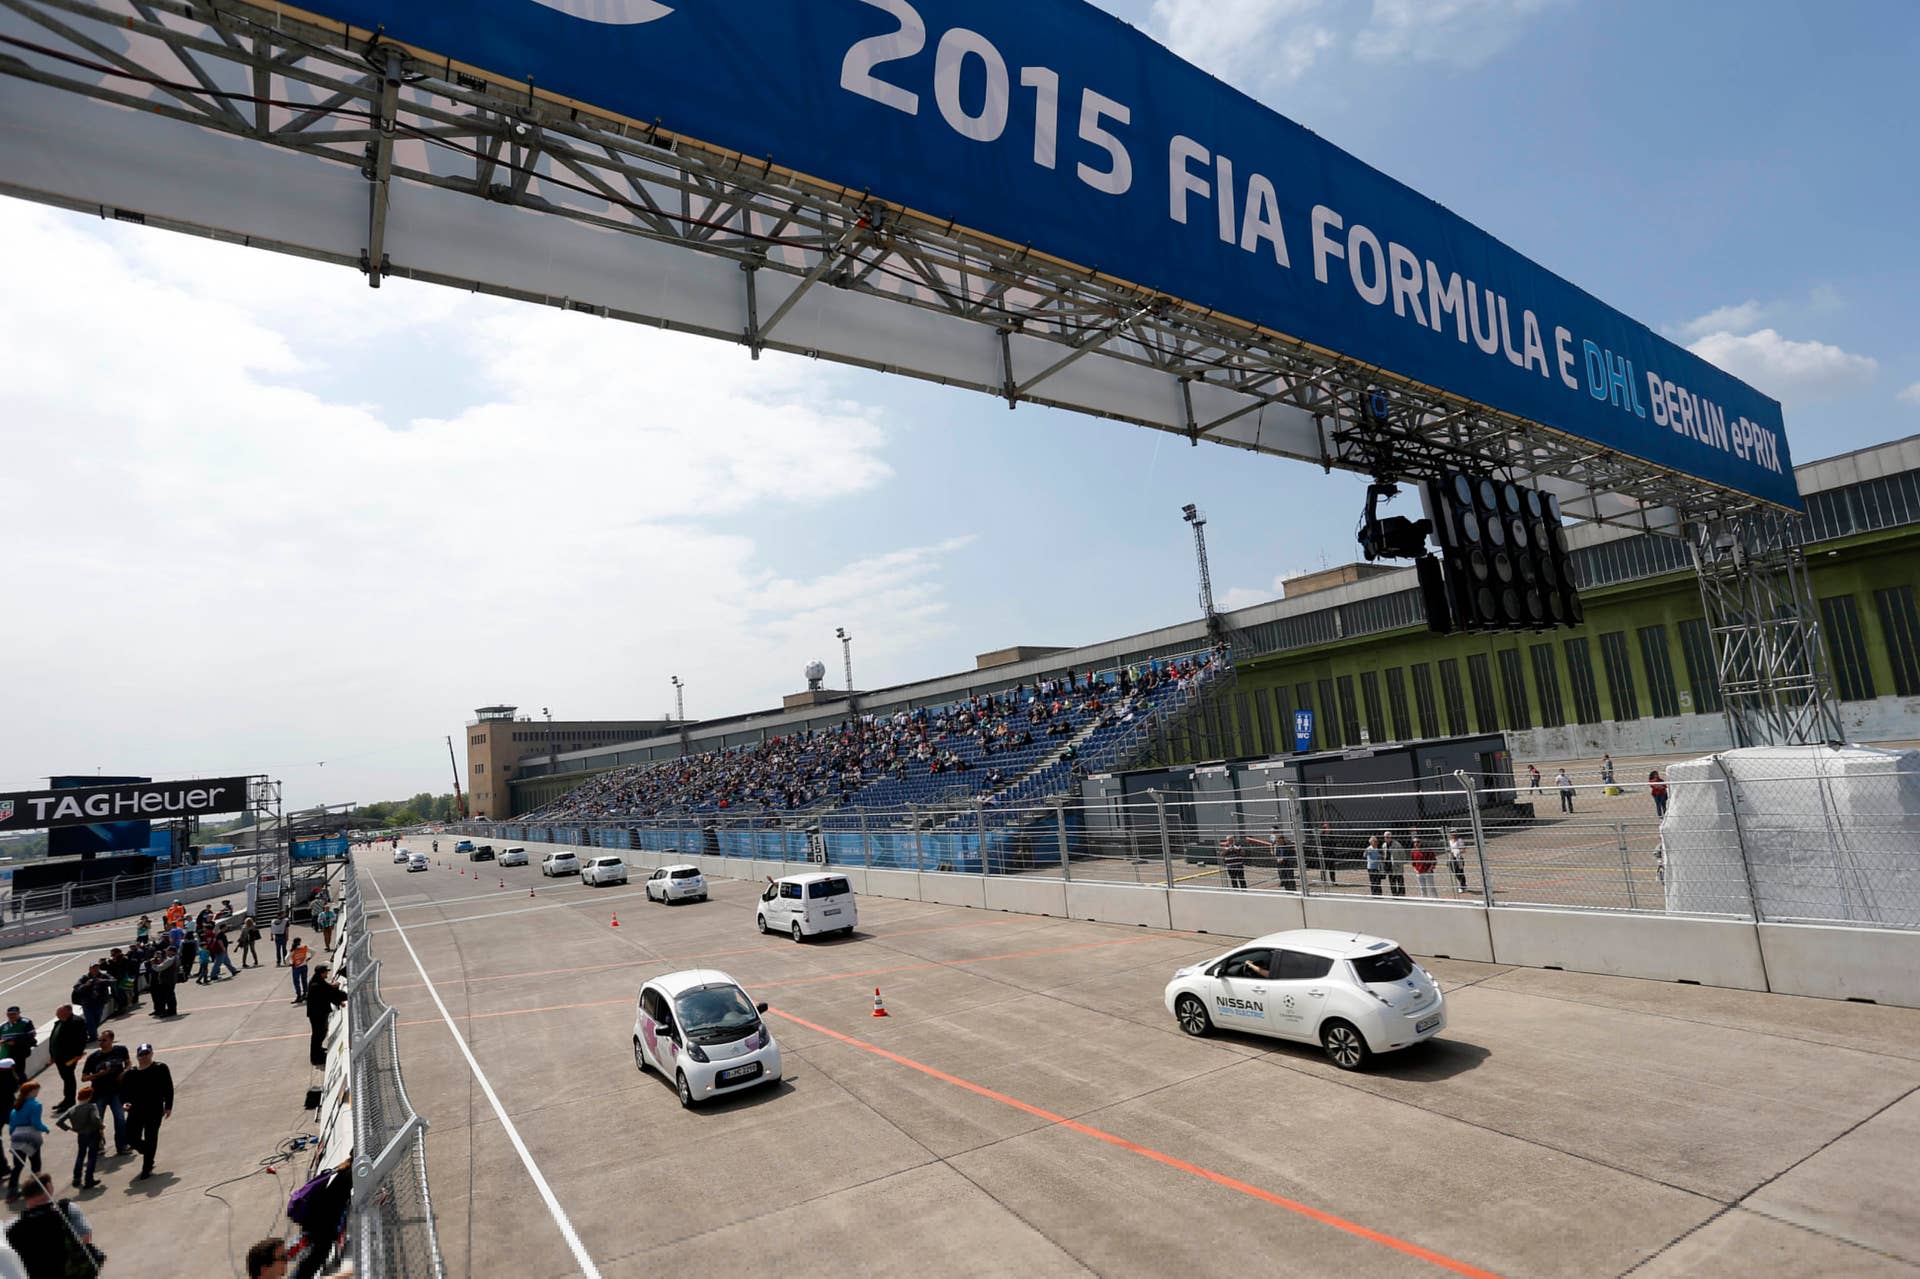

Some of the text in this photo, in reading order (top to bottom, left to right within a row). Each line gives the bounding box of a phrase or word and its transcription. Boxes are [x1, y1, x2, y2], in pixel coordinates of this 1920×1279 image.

[841, 0, 1783, 475] 2015 FIA FORMULA E DHL BERLIN ePRIX
[1680, 690, 1692, 708] 5
[27, 787, 226, 821] TAGHeuer
[814, 835, 822, 863] 150
[1216, 996, 1264, 1012] NISSAN
